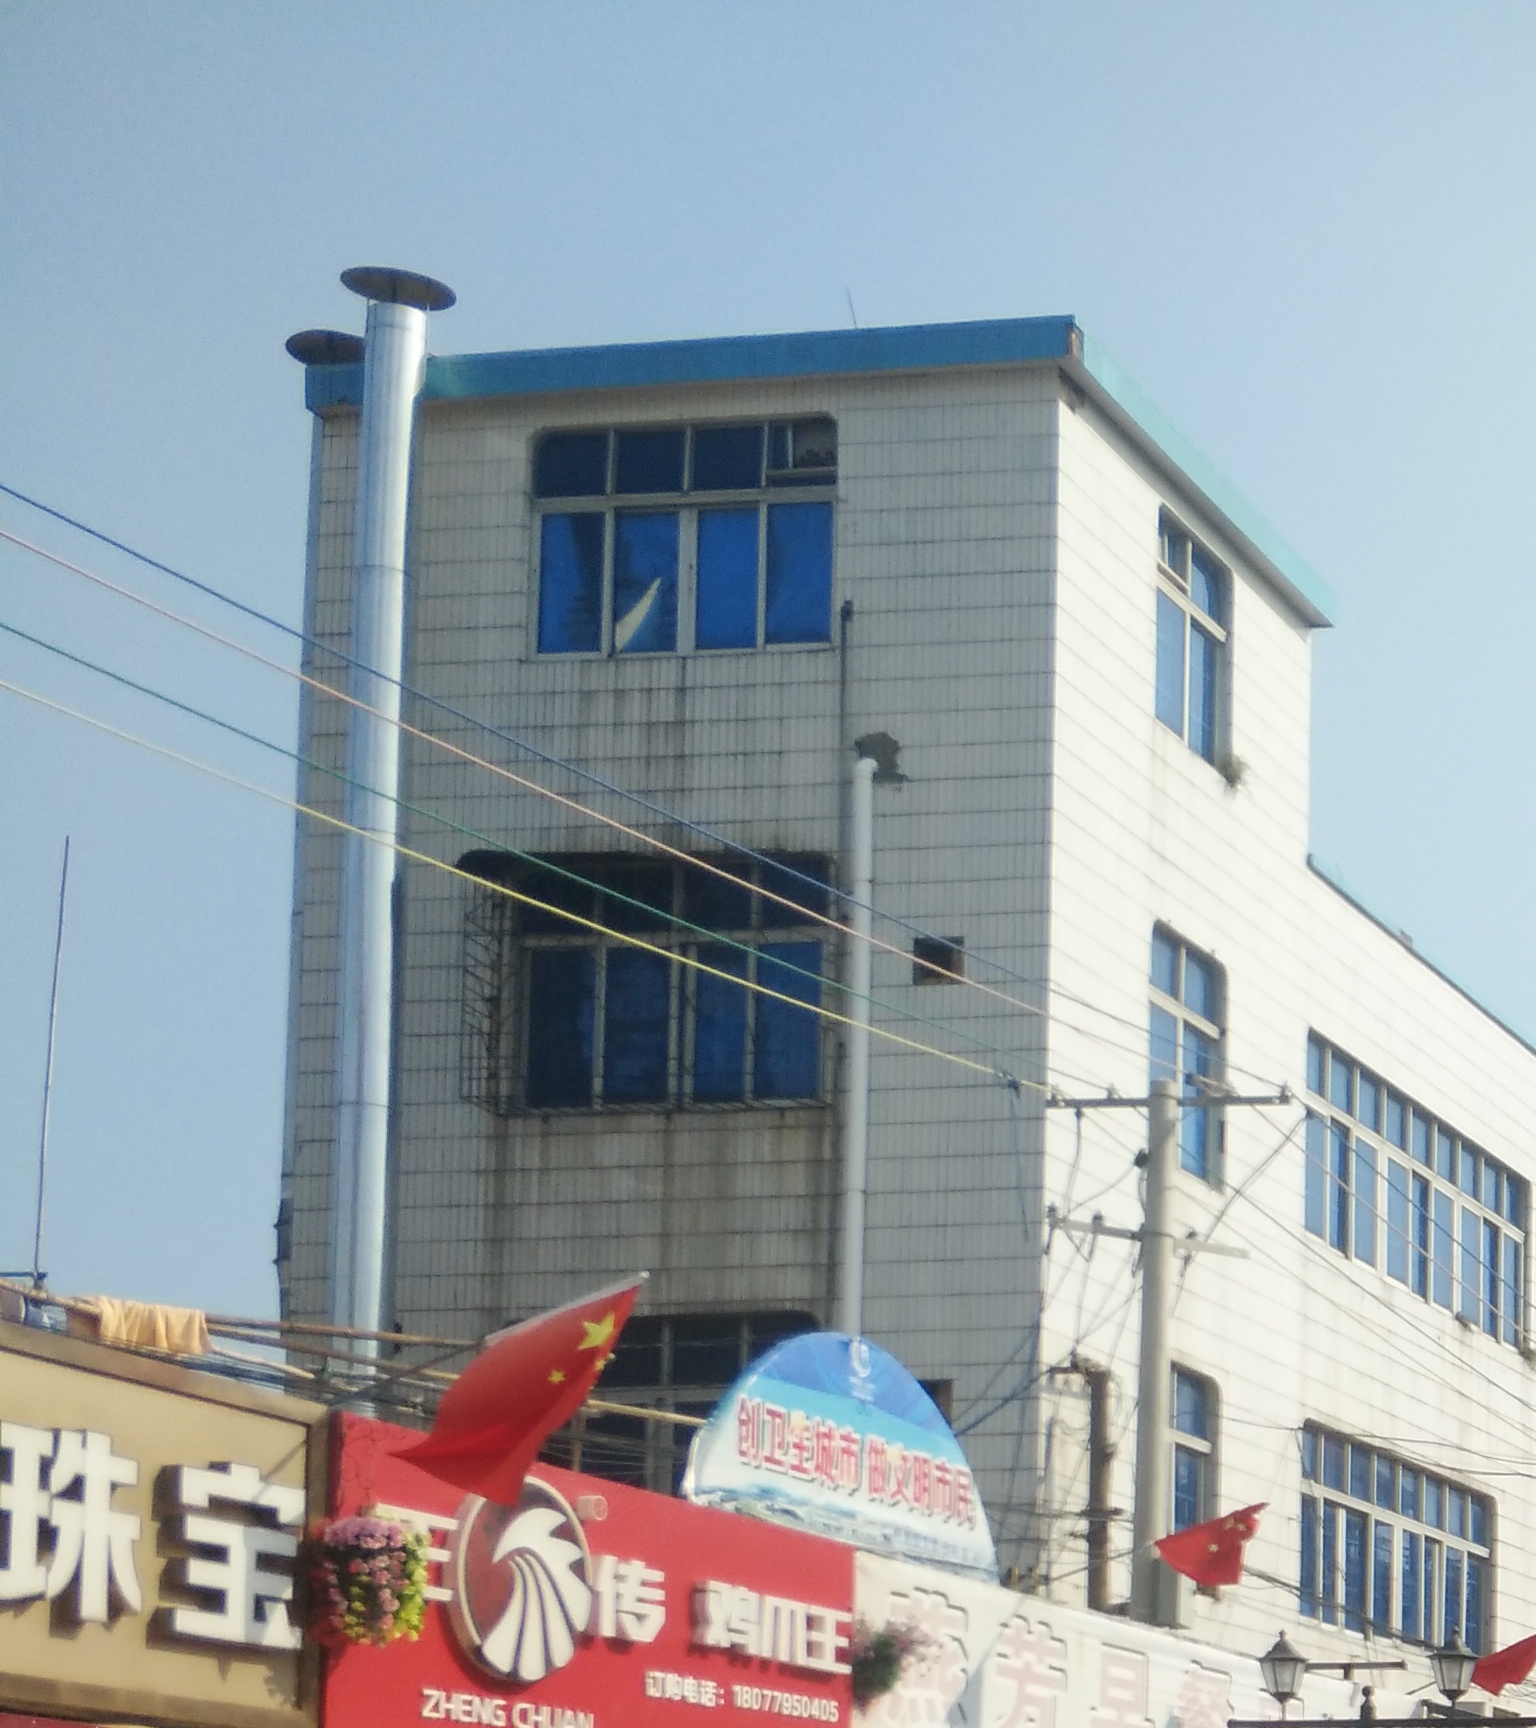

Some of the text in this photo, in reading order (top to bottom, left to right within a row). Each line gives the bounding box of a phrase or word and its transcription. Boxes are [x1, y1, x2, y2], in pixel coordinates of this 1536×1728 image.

[0, 1421, 306, 1651] 珠宝
[595, 1553, 667, 1643] 传
[421, 1687, 507, 1728] ZHENG
[732, 1685, 839, 1723] 18077950405
